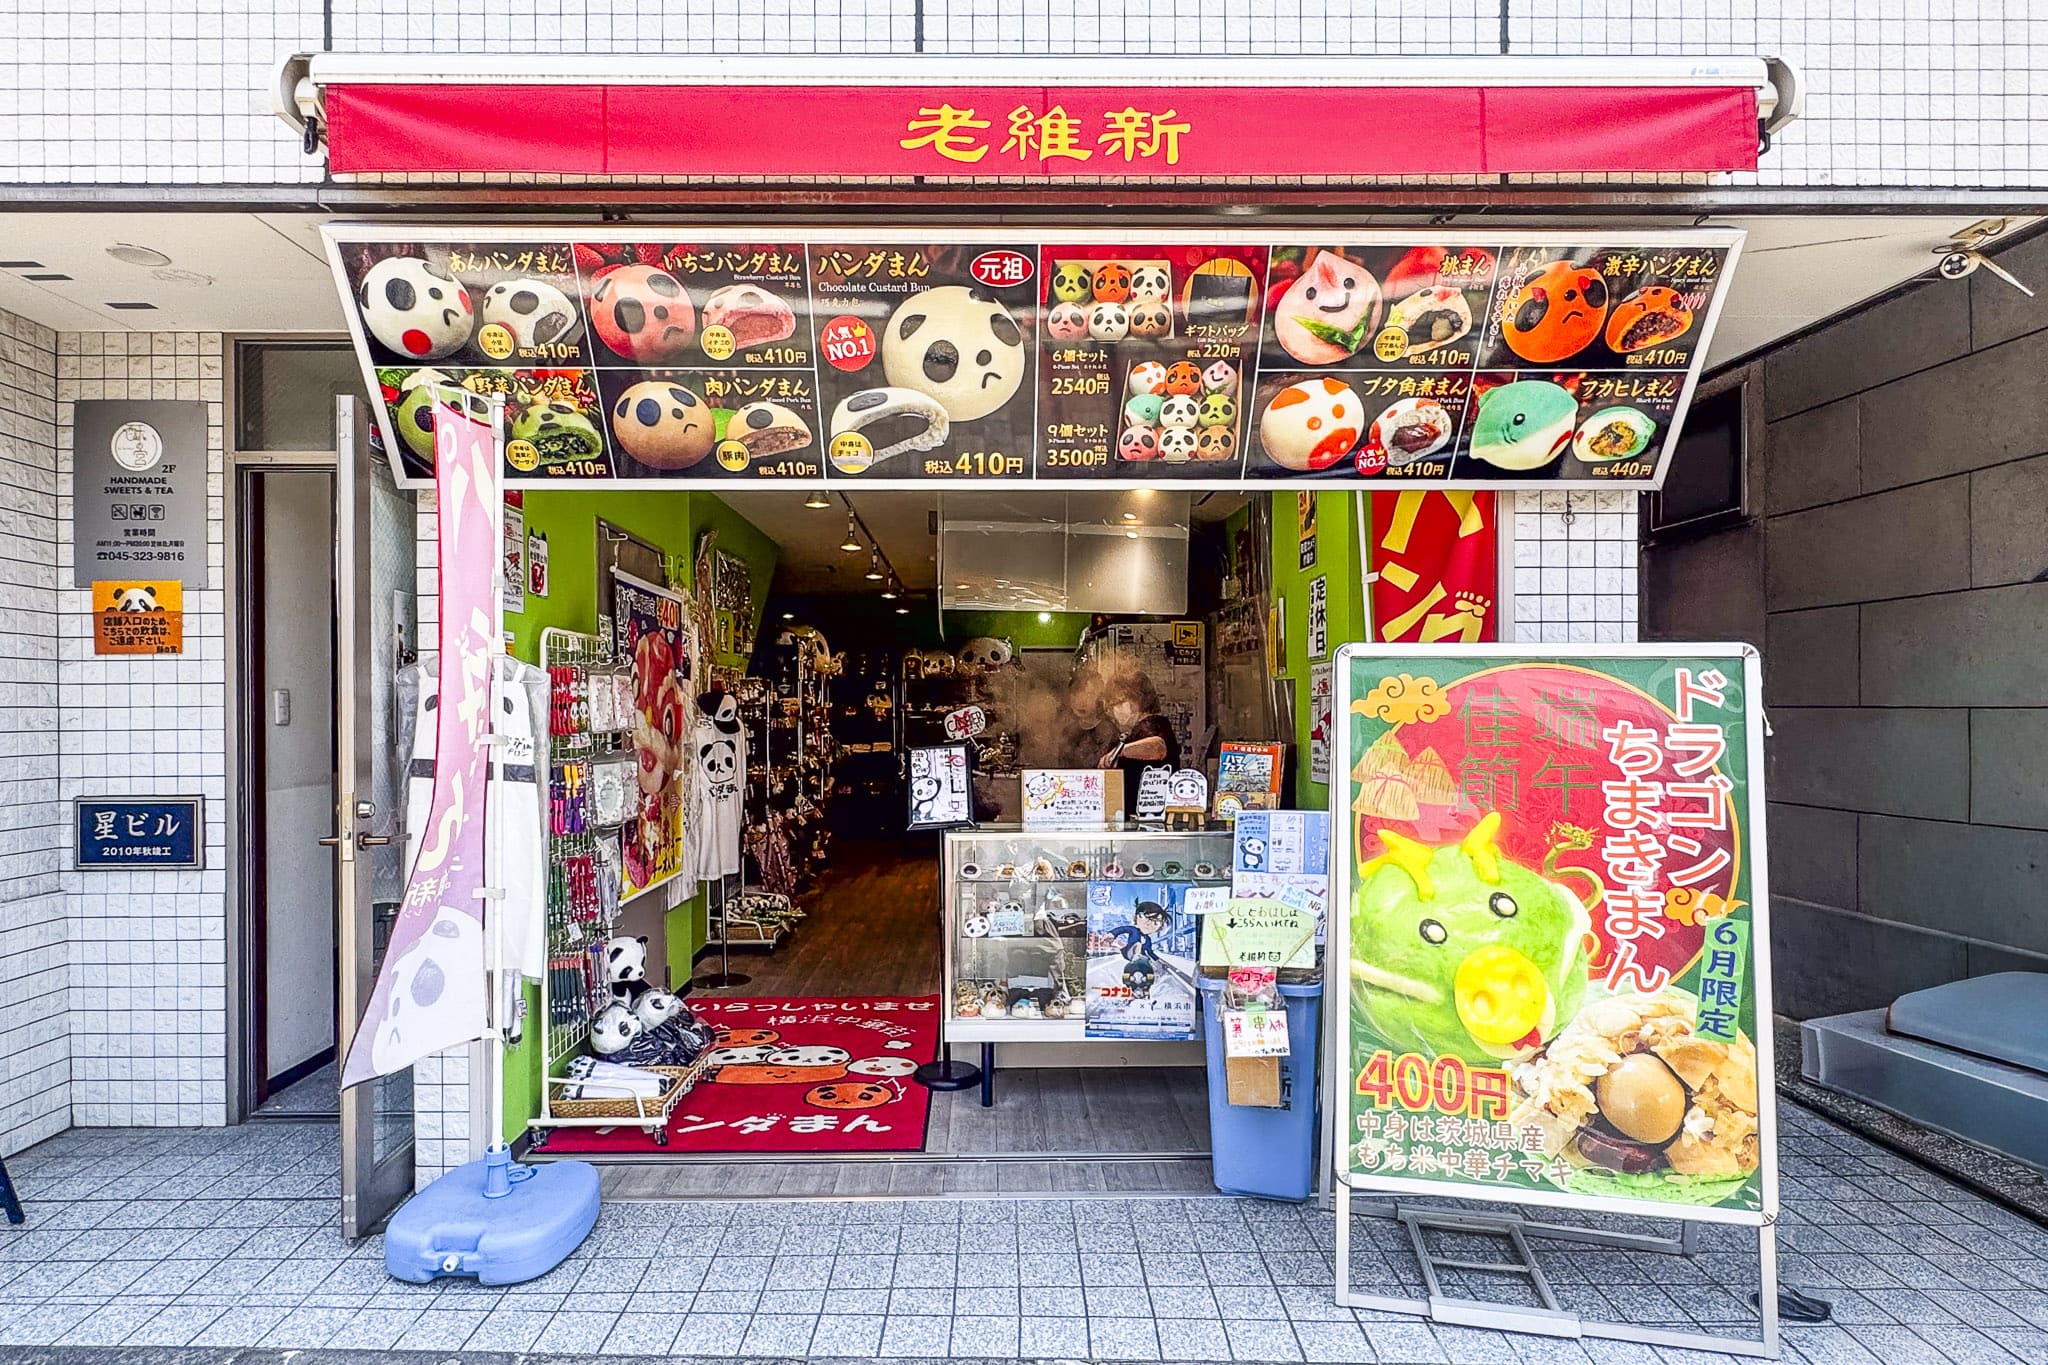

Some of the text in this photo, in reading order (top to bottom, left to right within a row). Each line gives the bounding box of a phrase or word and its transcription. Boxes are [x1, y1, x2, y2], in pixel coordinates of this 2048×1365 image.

[900, 104, 1191, 165] 老維新
[449, 251, 568, 273] あんパンダまん
[663, 252, 800, 273] いちごパンダまん
[817, 251, 931, 277] パンダまん
[979, 257, 1024, 281] 元祖
[1439, 255, 1491, 276] 桃まん
[1603, 255, 1717, 277] 激辛パンダまん
[818, 283, 930, 292] Chocolate Custard Bun
[827, 326, 853, 342] 人気
[1184, 325, 1249, 338] ギフトバッグ
[518, 343, 581, 359] 税込410円
[745, 349, 807, 364] 税込410円
[828, 339, 871, 361] NO.1
[1052, 350, 1108, 362] 6個セット
[1409, 350, 1471, 365] 税込410円
[1625, 350, 1687, 364] 税込410円
[474, 376, 592, 396] 野菜パンダまん
[704, 377, 810, 397] 肉パンダまん
[1051, 377, 1110, 395] 2540円
[1363, 376, 1469, 396] ブタ角煮まん
[1581, 379, 1677, 398] フカヒレまん
[1048, 424, 1109, 437] 9個セット
[722, 450, 745, 461] 豚肉
[924, 452, 1024, 475] 税込410円
[1047, 449, 1108, 466] 3500円
[1358, 450, 1375, 458] 人気
[1358, 457, 1387, 469] NO.2
[162, 464, 177, 473] 2F
[548, 461, 607, 475] 税込410円
[758, 461, 817, 476] 税込410円
[1386, 462, 1445, 476] 税込410円
[1592, 462, 1653, 475] 税込440円
[104, 486, 174, 494] SWEETS & TEA
[110, 476, 167, 485] HANDMADE
[108, 551, 185, 561] 045-323-9816
[1316, 577, 1326, 654] 定休日
[1456, 687, 1521, 811] 佳節
[1532, 687, 1599, 815] 端午
[1665, 668, 1734, 887] ドラゴン
[94, 810, 180, 840] 星ビル
[102, 847, 172, 856] 2010年秋竣工
[1603, 720, 1669, 995] ちまきまん
[1698, 920, 1740, 1041] 6月限定
[690, 1002, 935, 1012] いらっしゃいませ
[767, 1013, 917, 1039] 横浜中華街
[1356, 1050, 1511, 1120] 400円
[595, 1113, 893, 1135] ンダまん
[1357, 1111, 1546, 1153] 中身は茨城県産
[1357, 1142, 1575, 1187] もち米中華チマキ
